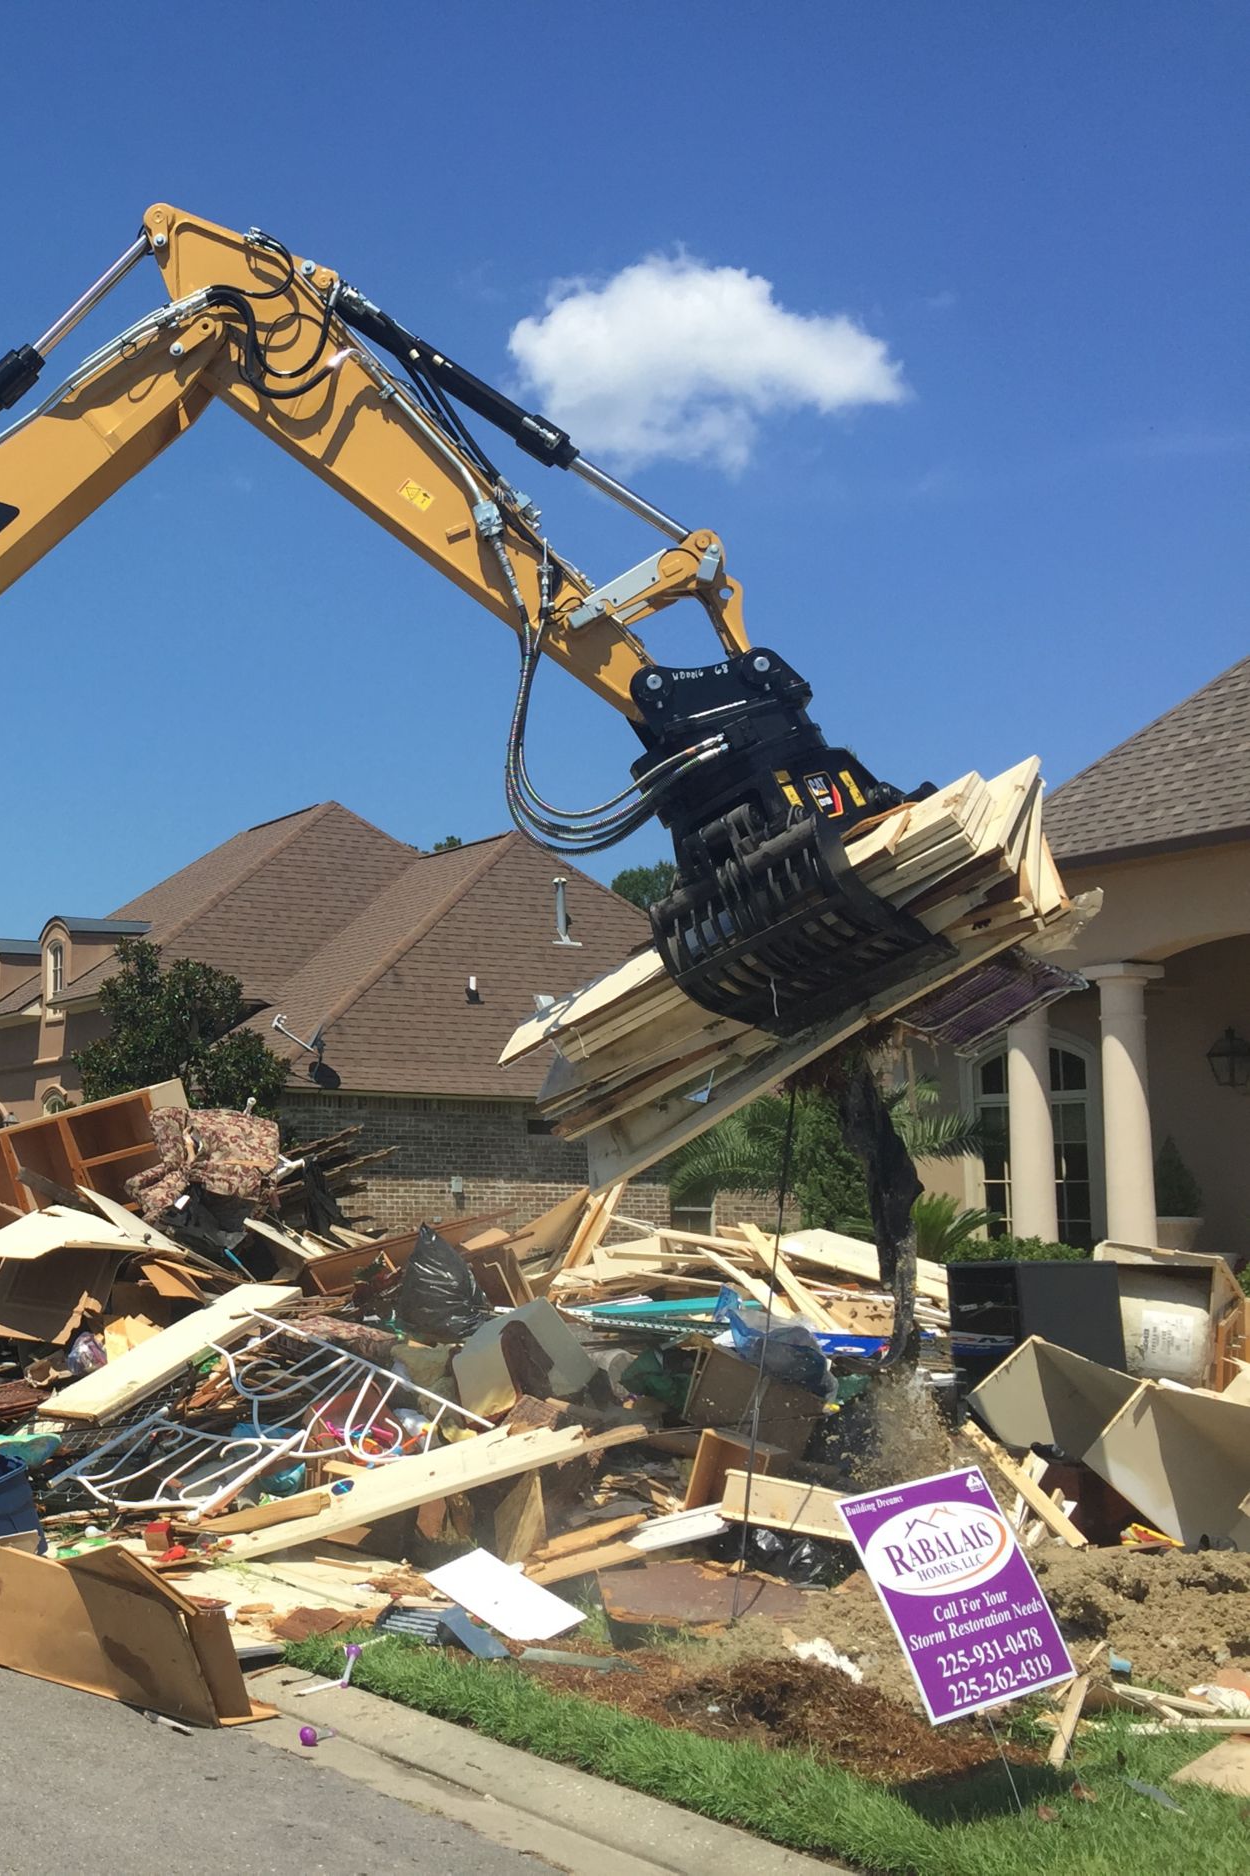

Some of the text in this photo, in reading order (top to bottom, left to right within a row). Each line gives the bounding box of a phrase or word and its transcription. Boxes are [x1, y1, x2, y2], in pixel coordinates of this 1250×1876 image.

[807, 776, 830, 797] CAT
[845, 1495, 904, 1517] Building Dreams
[883, 1521, 994, 1577] RABALAIS
[916, 1553, 986, 1582] HOMES, LLC
[909, 1598, 1044, 1652] Storm Restoration Needs
[933, 1590, 1008, 1622] Call For Your
[936, 1626, 1043, 1678] 225-931-0478
[947, 1653, 1053, 1707] 225-262-4319
